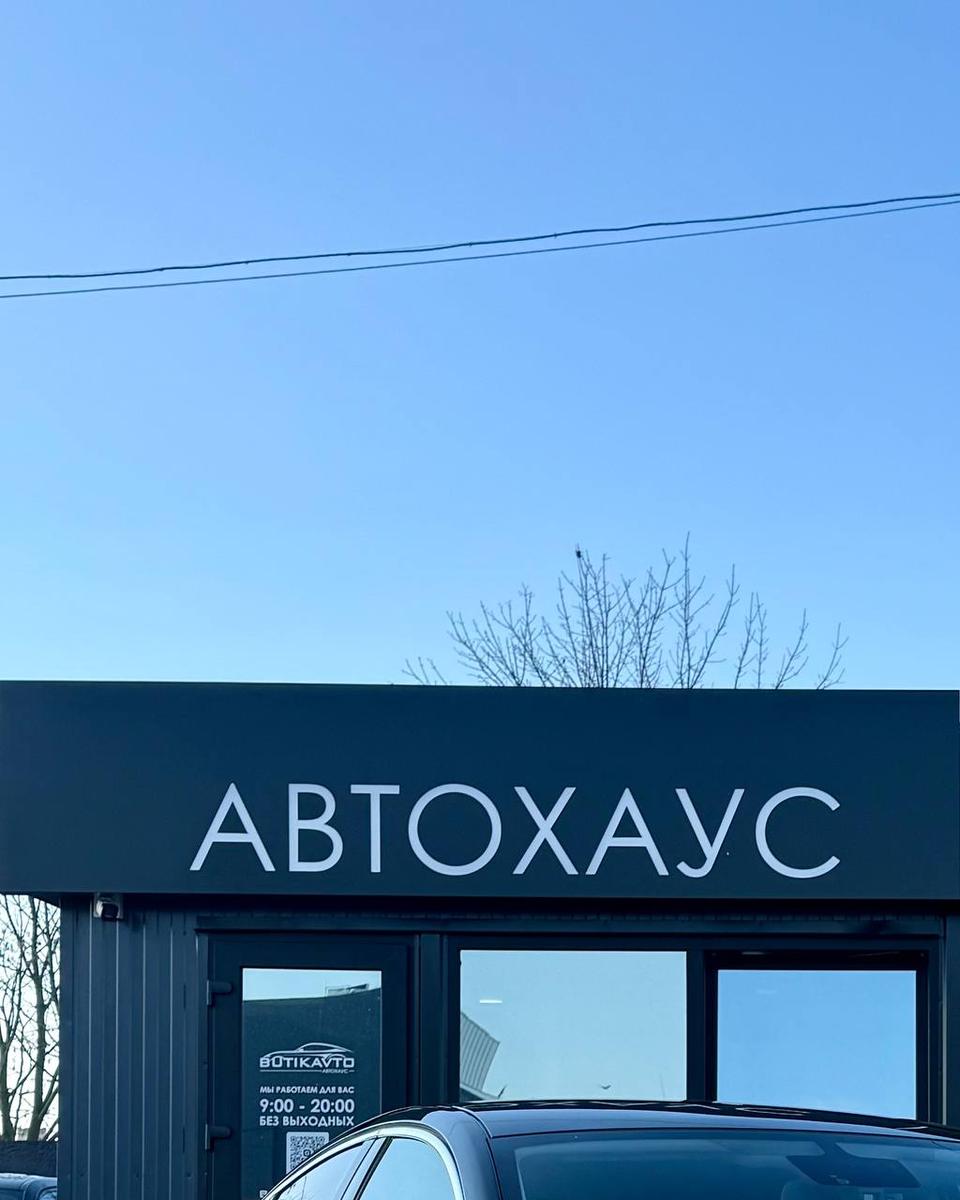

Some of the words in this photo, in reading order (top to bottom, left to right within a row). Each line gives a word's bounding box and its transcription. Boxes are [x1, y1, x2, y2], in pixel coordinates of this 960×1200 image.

[189, 783, 841, 878] АВТОХАУС
[259, 1057, 355, 1068] BUTIKAVTO
[259, 1086, 274, 1094] МЫ
[275, 1086, 318, 1094] РАБОТАЕМ
[319, 1086, 336, 1094] ДЛЯ
[337, 1086, 355, 1094] ВАС
[259, 1098, 294, 1113] 9:00
[310, 1098, 355, 1113] 20:00
[259, 1116, 279, 1126] БЕЗ
[282, 1116, 355, 1127] ВЫХОДНЫХ
